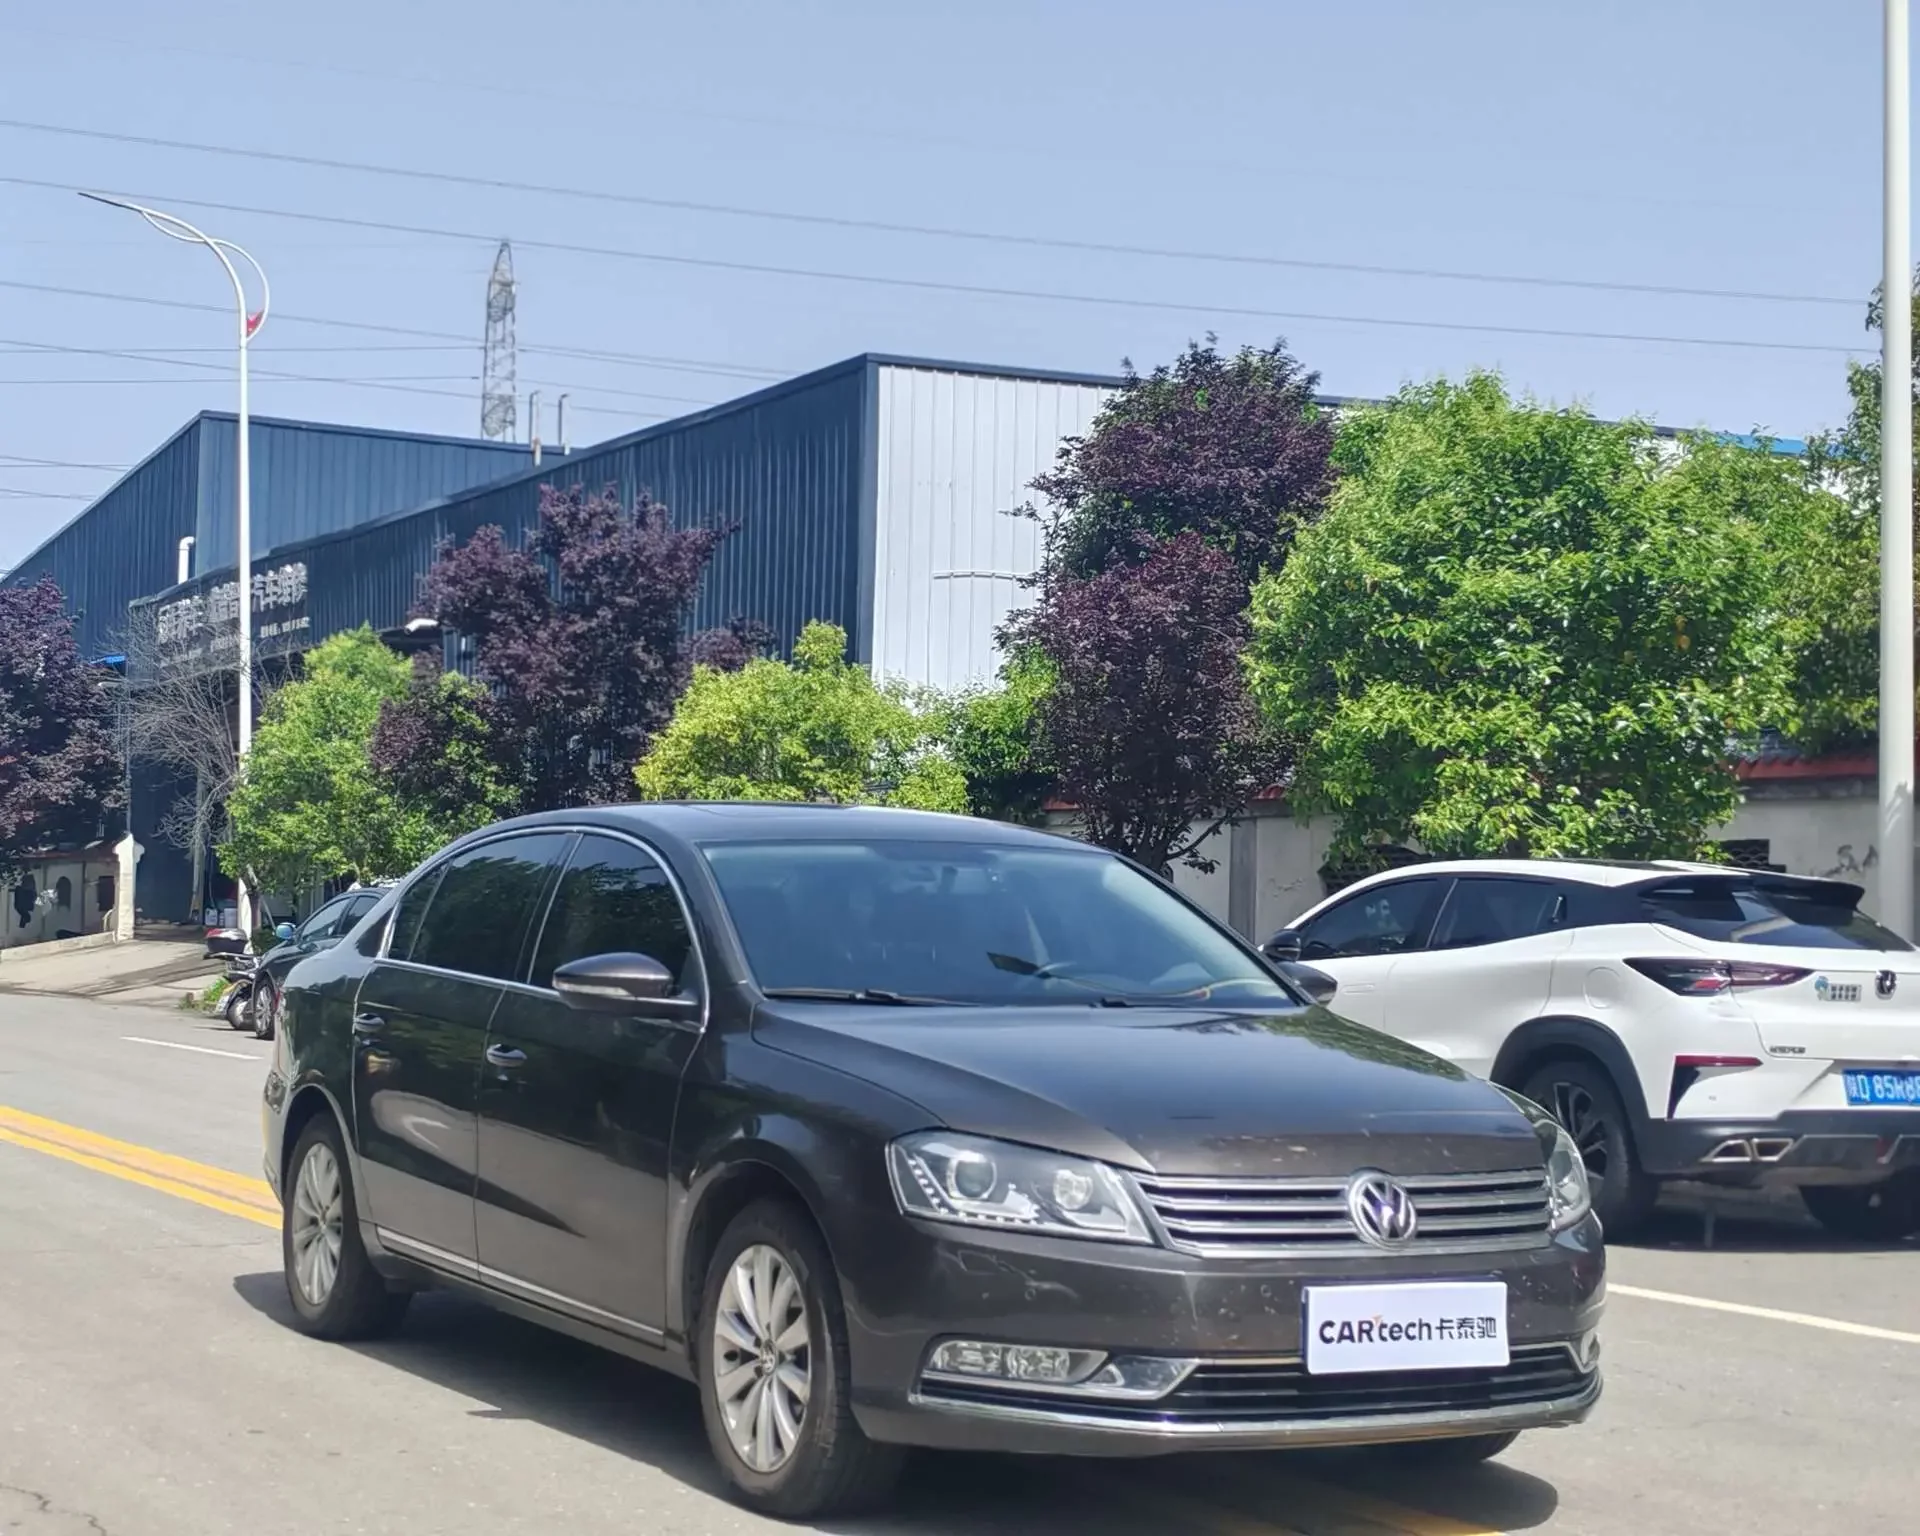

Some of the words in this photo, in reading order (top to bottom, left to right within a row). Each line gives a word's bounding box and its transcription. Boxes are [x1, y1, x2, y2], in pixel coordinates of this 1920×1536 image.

[1319, 1317, 1432, 1344] CARtech
[1435, 1316, 1497, 1340] 卡泰驰
